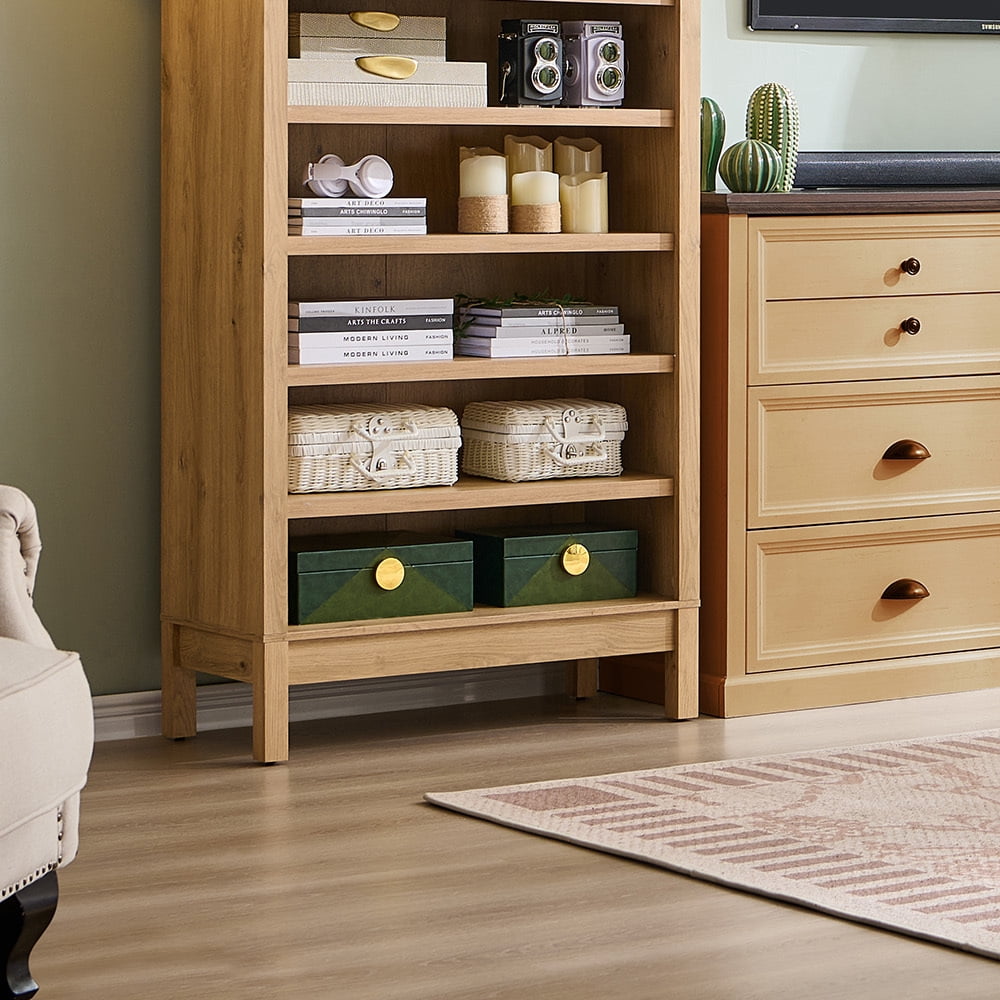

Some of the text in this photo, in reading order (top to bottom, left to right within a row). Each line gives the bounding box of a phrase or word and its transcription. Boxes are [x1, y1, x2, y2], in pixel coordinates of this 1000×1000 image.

[339, 208, 355, 216] ARTS
[354, 305, 397, 315] KINFOLK
[346, 318, 365, 326] ARTS
[380, 317, 408, 325] CRAFTS
[540, 327, 578, 336] ALPRED
[343, 335, 379, 343] MODERN
[381, 334, 410, 342] LIVING
[381, 349, 410, 357] LIVING
